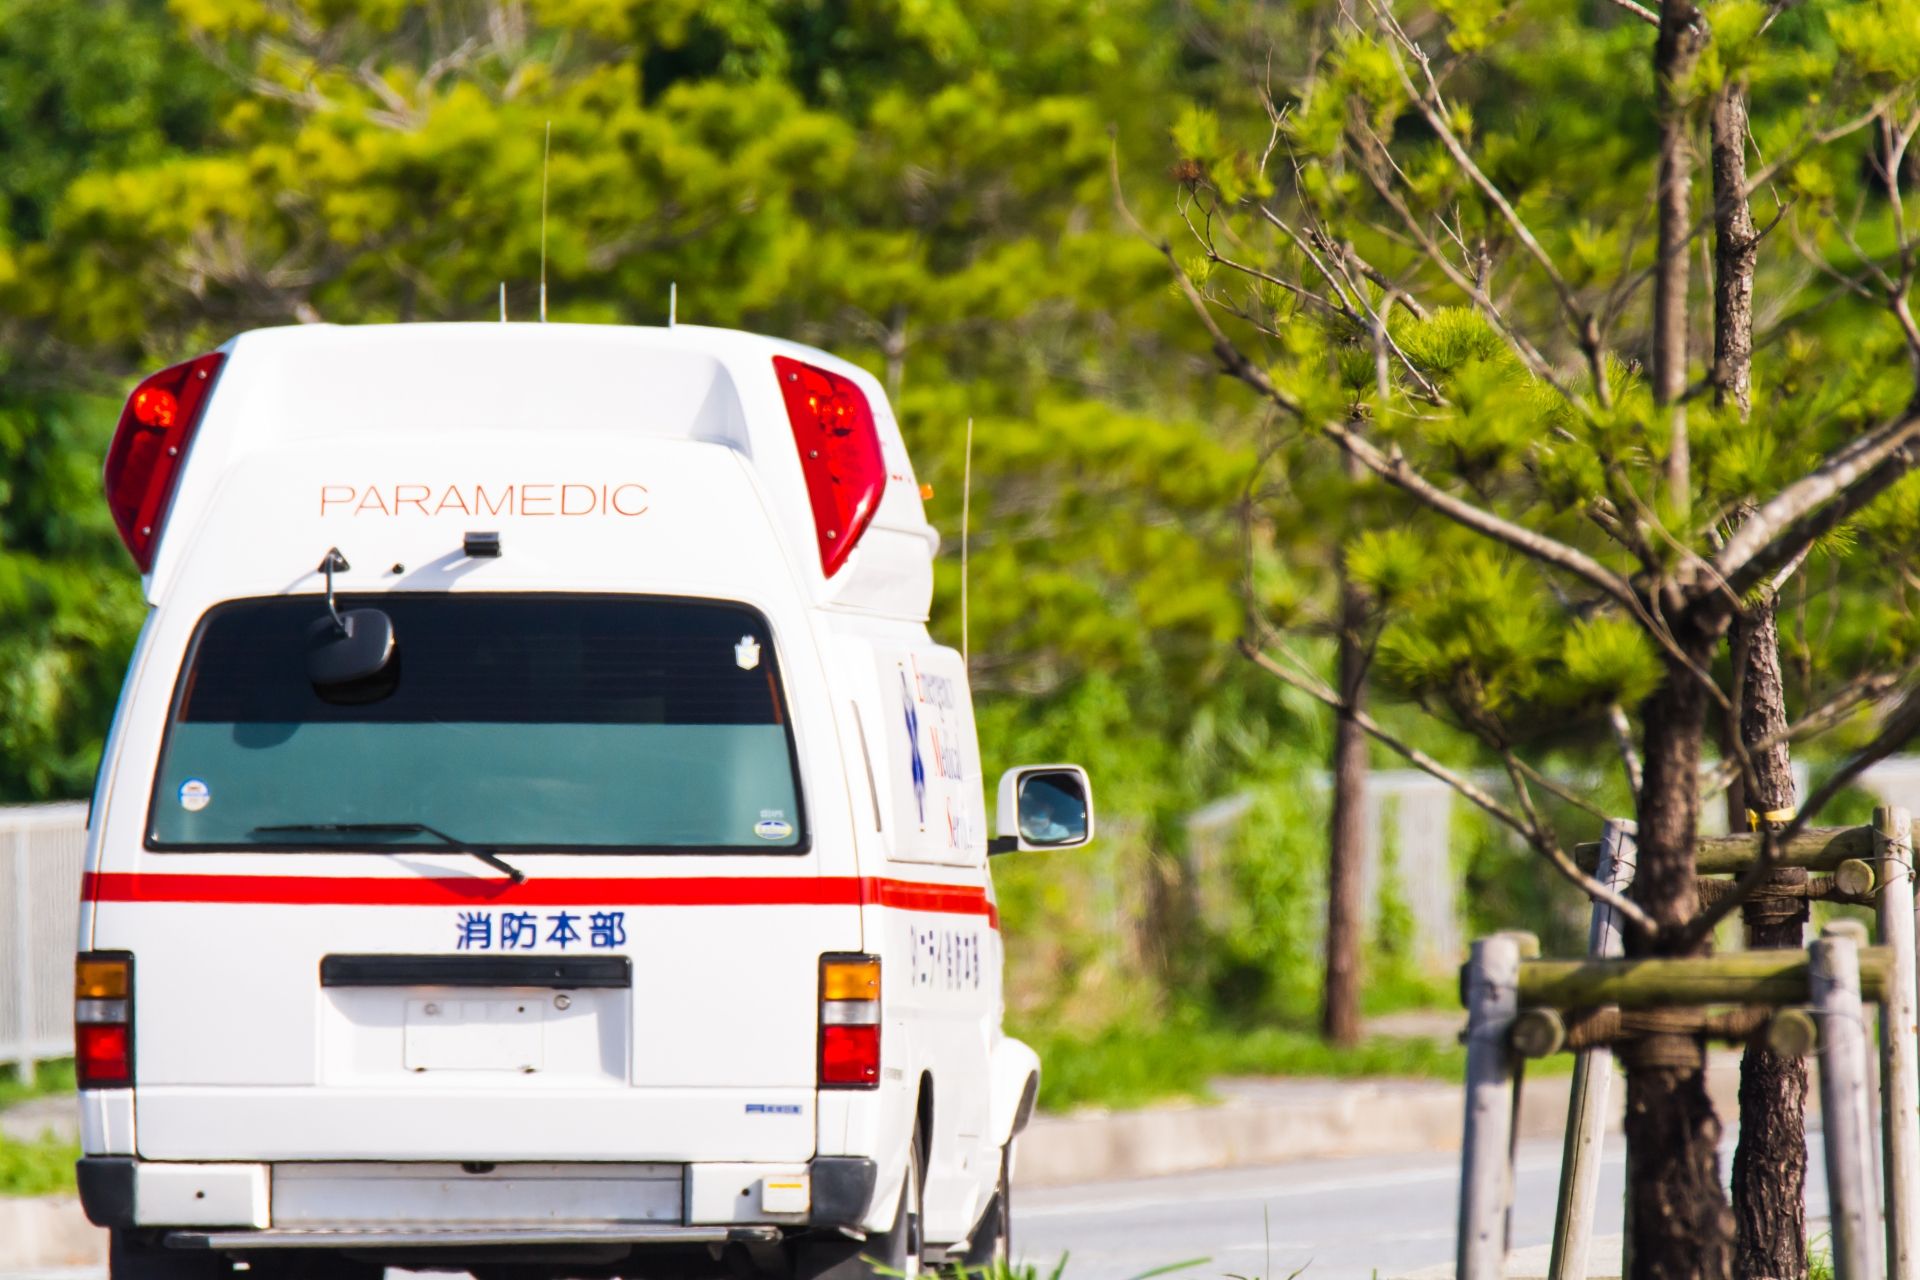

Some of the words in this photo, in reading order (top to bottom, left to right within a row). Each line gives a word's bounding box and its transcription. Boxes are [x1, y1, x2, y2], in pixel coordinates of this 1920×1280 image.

[321, 484, 648, 516] PARAMEDIC
[456, 910, 626, 950] 消防本部
